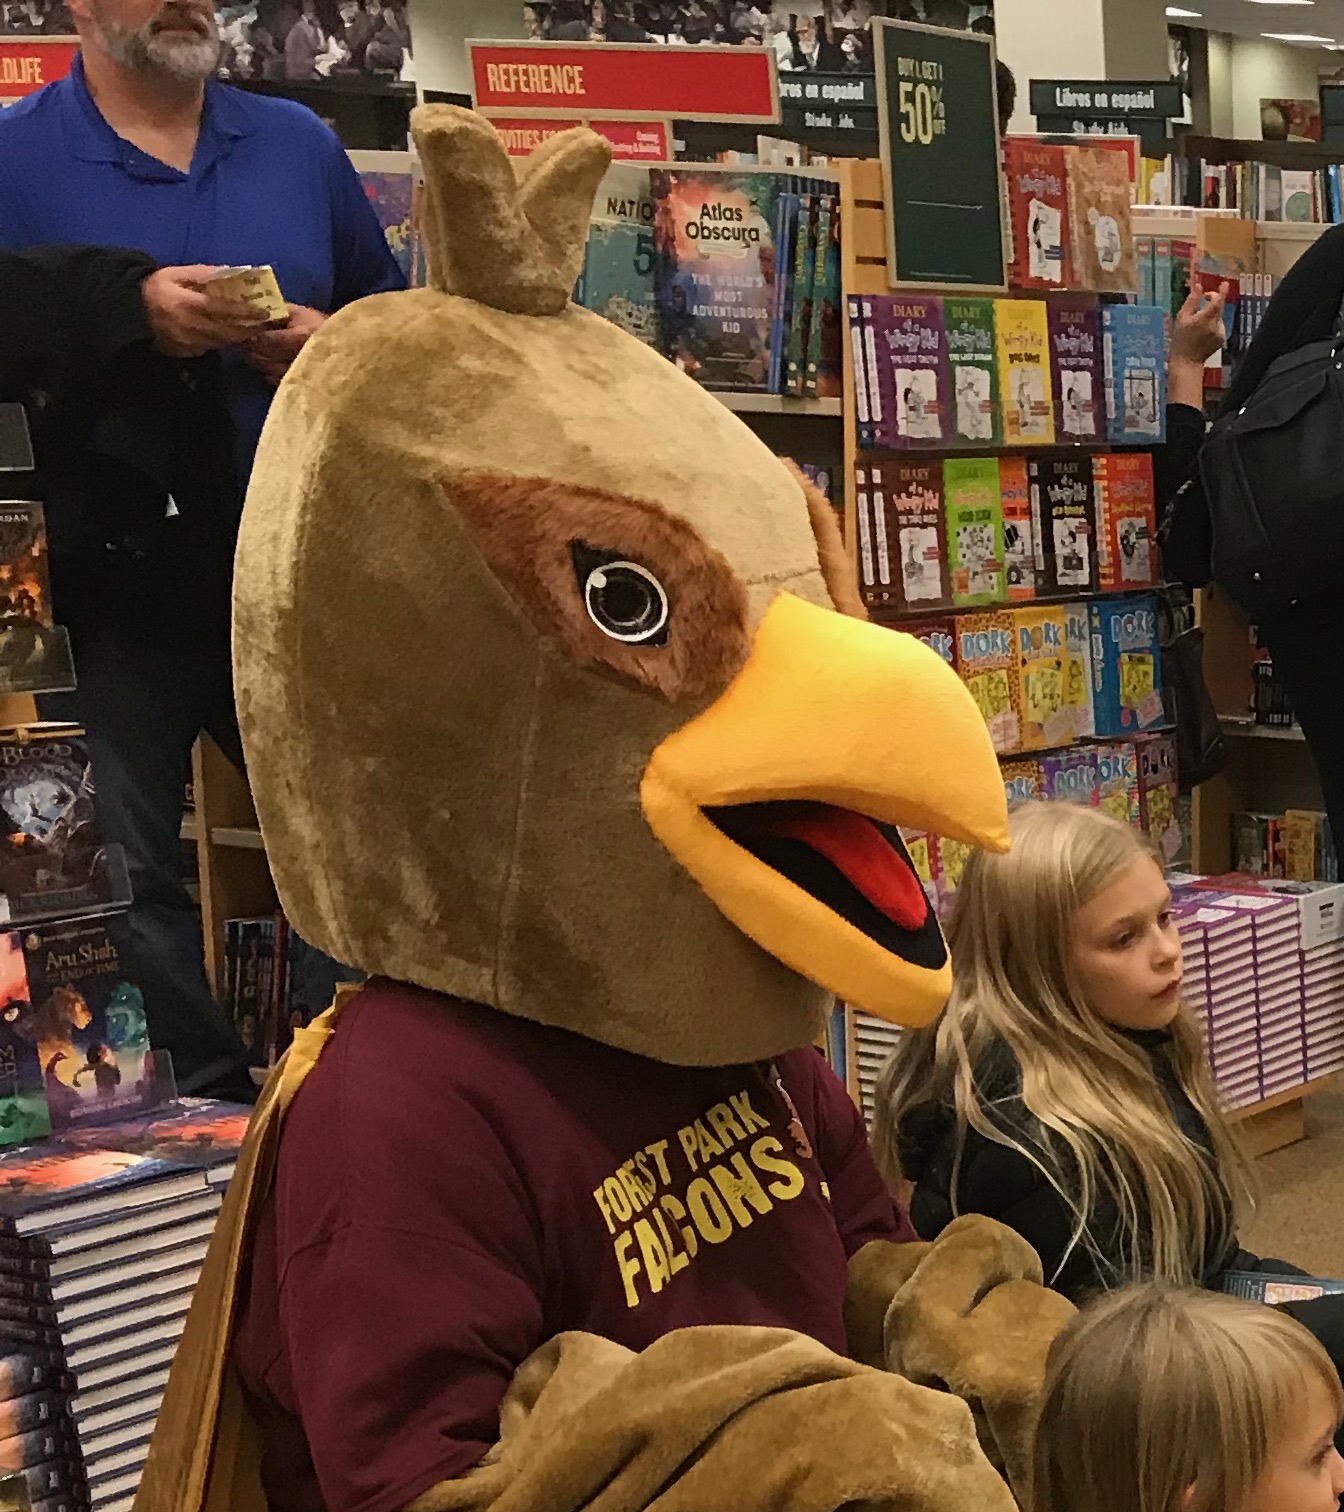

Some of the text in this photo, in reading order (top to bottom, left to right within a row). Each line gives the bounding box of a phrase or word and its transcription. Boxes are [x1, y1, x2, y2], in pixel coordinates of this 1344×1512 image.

[0, 56, 44, 83] DLIFE
[487, 63, 586, 96] REFERENCE
[922, 61, 938, 81] GET
[1055, 87, 1155, 112] Libros en español
[699, 202, 743, 223] Atlas
[685, 222, 760, 243] Obscura
[692, 273, 713, 285] THE
[714, 291, 743, 303] MOST
[692, 306, 769, 319] ADVENTUROUS
[892, 304, 928, 318] DIARY
[722, 321, 741, 334] KID
[1019, 621, 1062, 653] DORK
[1110, 610, 1155, 643] DORK
[961, 627, 1011, 661] DORK
[1054, 765, 1096, 795] DORK
[1099, 755, 1132, 782] ORK
[1004, 776, 1034, 804] ORK
[45, 948, 76, 972] Aru
[593, 1090, 770, 1235] FOREST PARK
[613, 1135, 805, 1309] FALCONS
